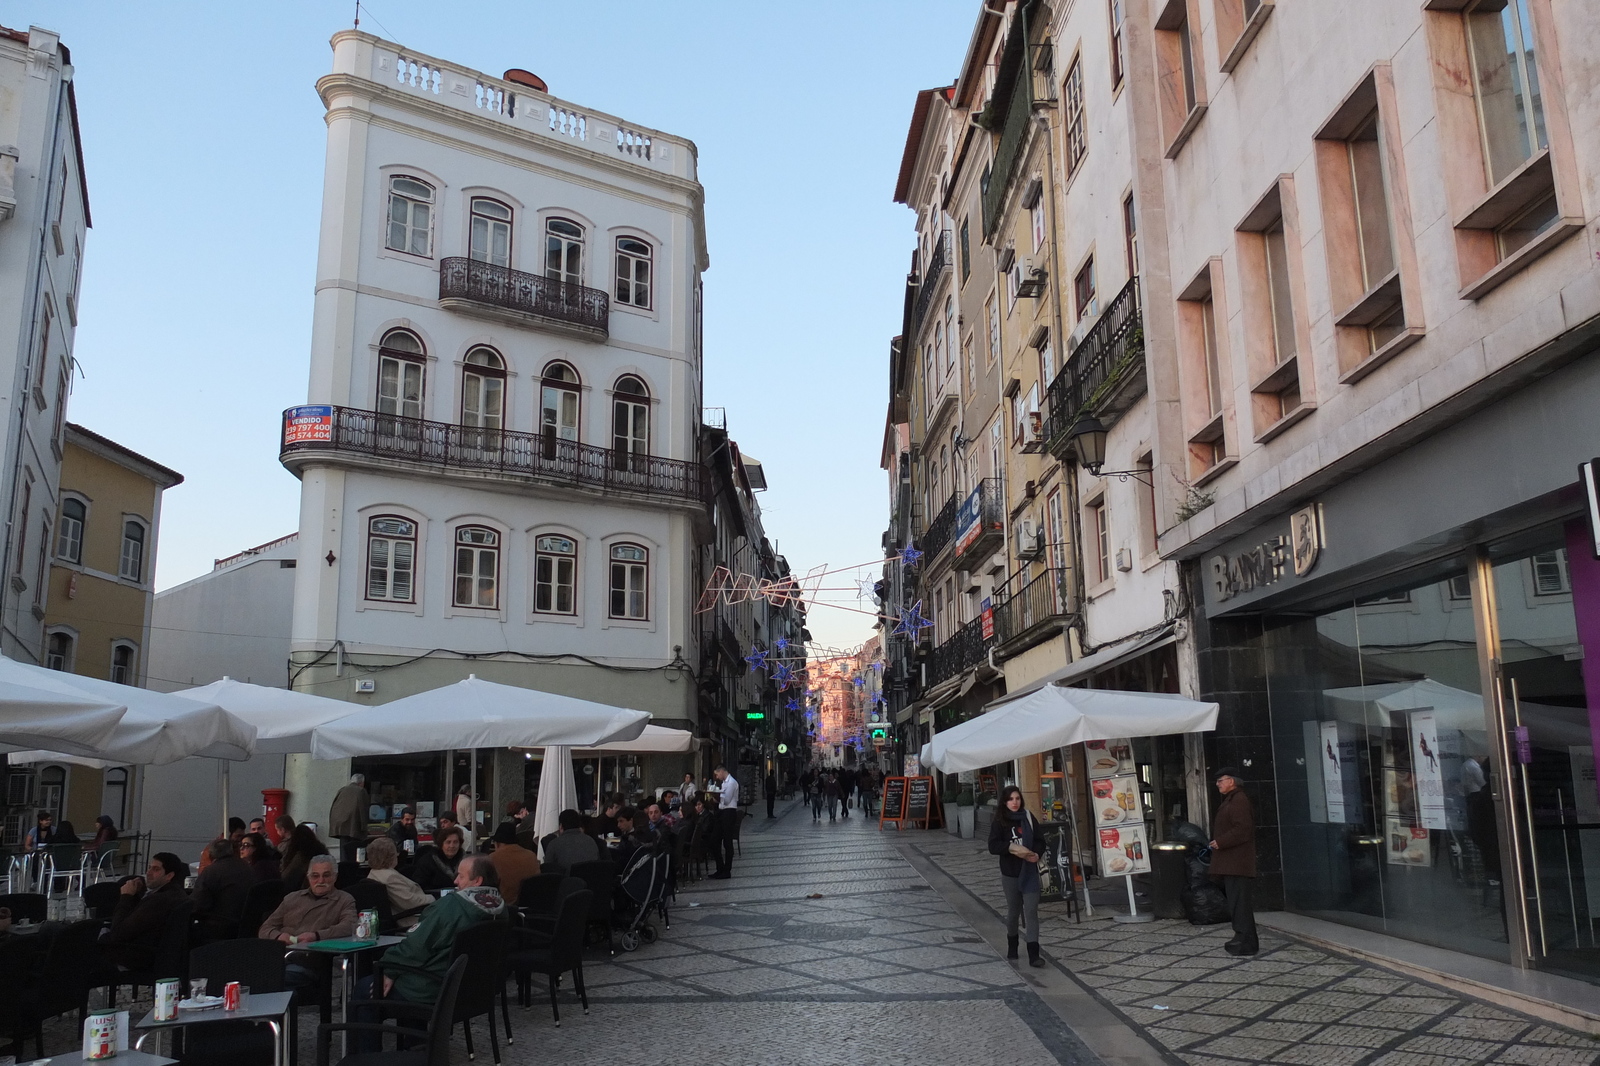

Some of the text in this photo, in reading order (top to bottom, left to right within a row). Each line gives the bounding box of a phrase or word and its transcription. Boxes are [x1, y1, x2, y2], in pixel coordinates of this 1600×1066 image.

[292, 417, 321, 425] VENDIDO
[297, 424, 312, 432] 797
[297, 431, 312, 439] 574
